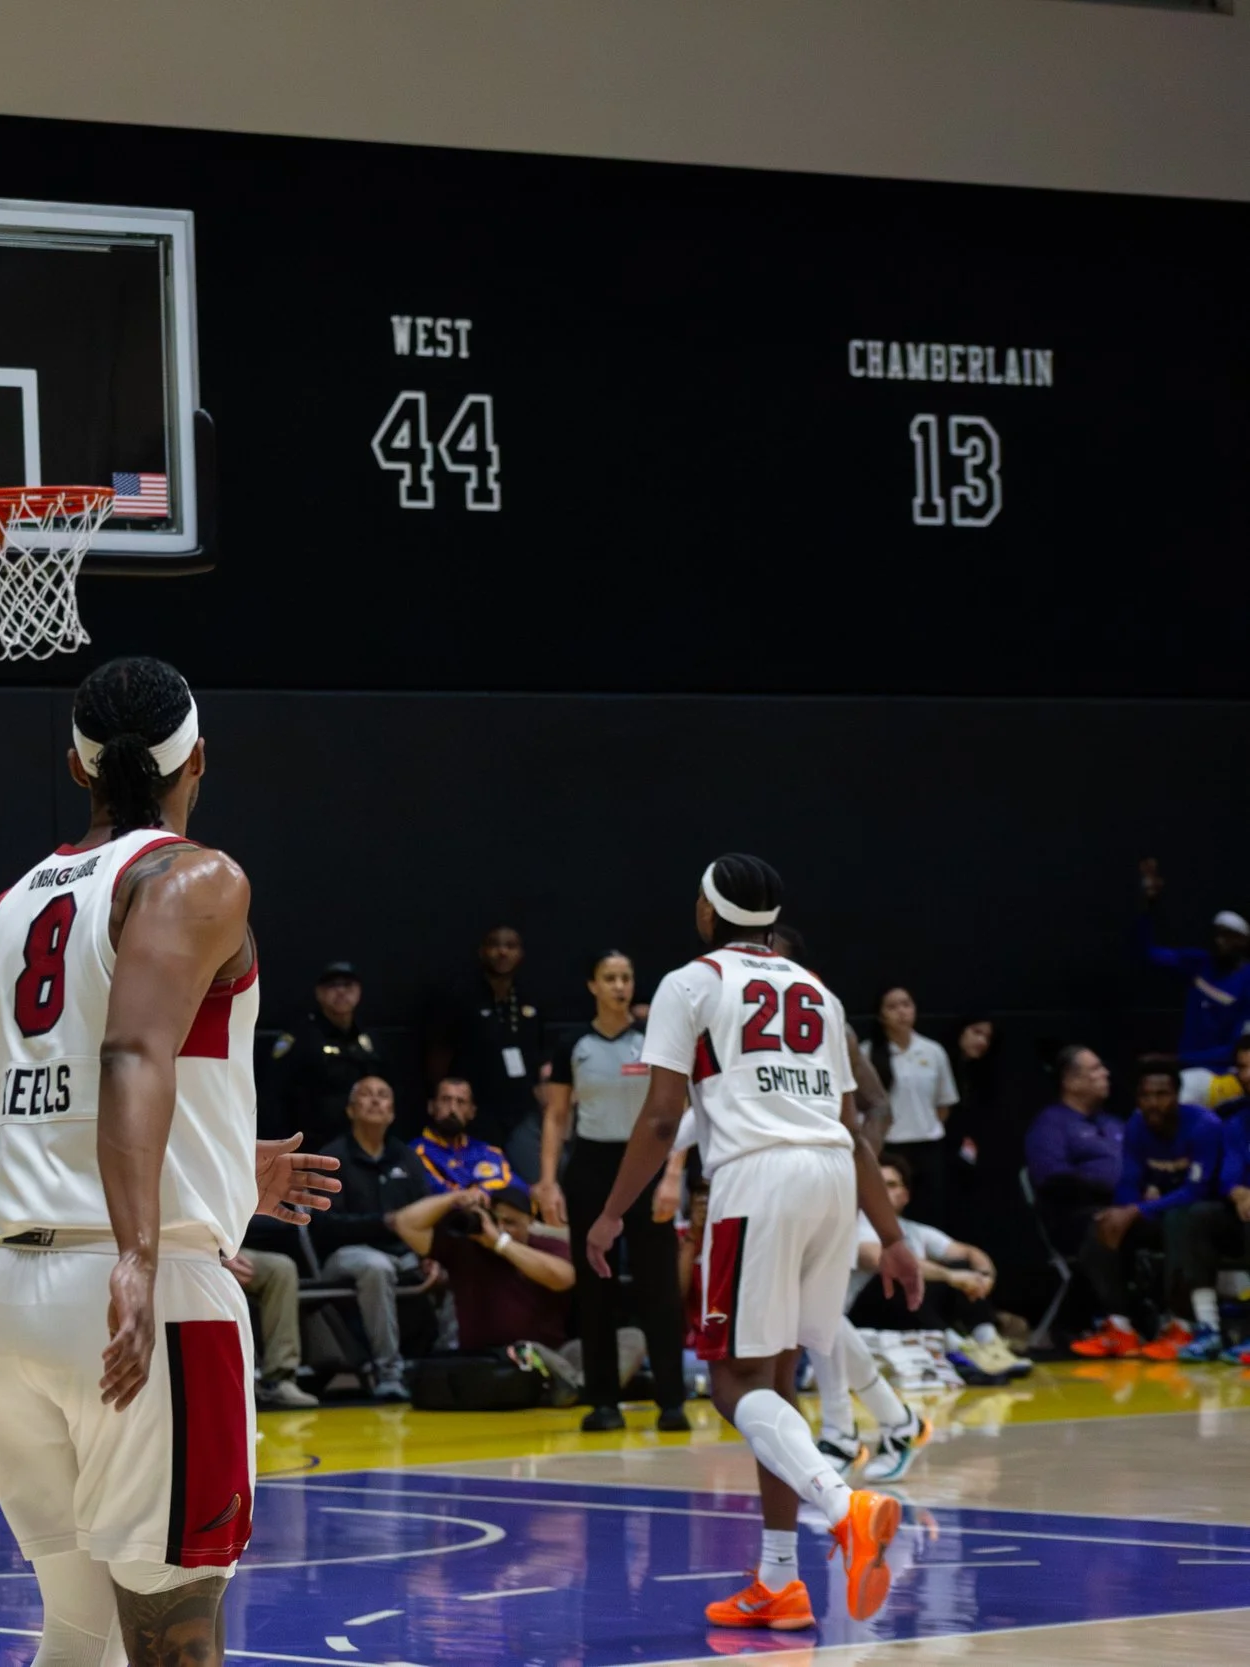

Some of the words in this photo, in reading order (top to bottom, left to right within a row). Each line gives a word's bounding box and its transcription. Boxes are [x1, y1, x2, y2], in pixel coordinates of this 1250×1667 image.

[390, 315, 473, 359] WEST
[848, 339, 1054, 387] CHAMBERLAIN
[371, 390, 502, 512] 44
[909, 413, 1003, 527] 13
[14, 892, 77, 1038] 8
[742, 979, 824, 1054] 26
[756, 1065, 811, 1095] SMITH
[812, 1069, 834, 1097] JR
